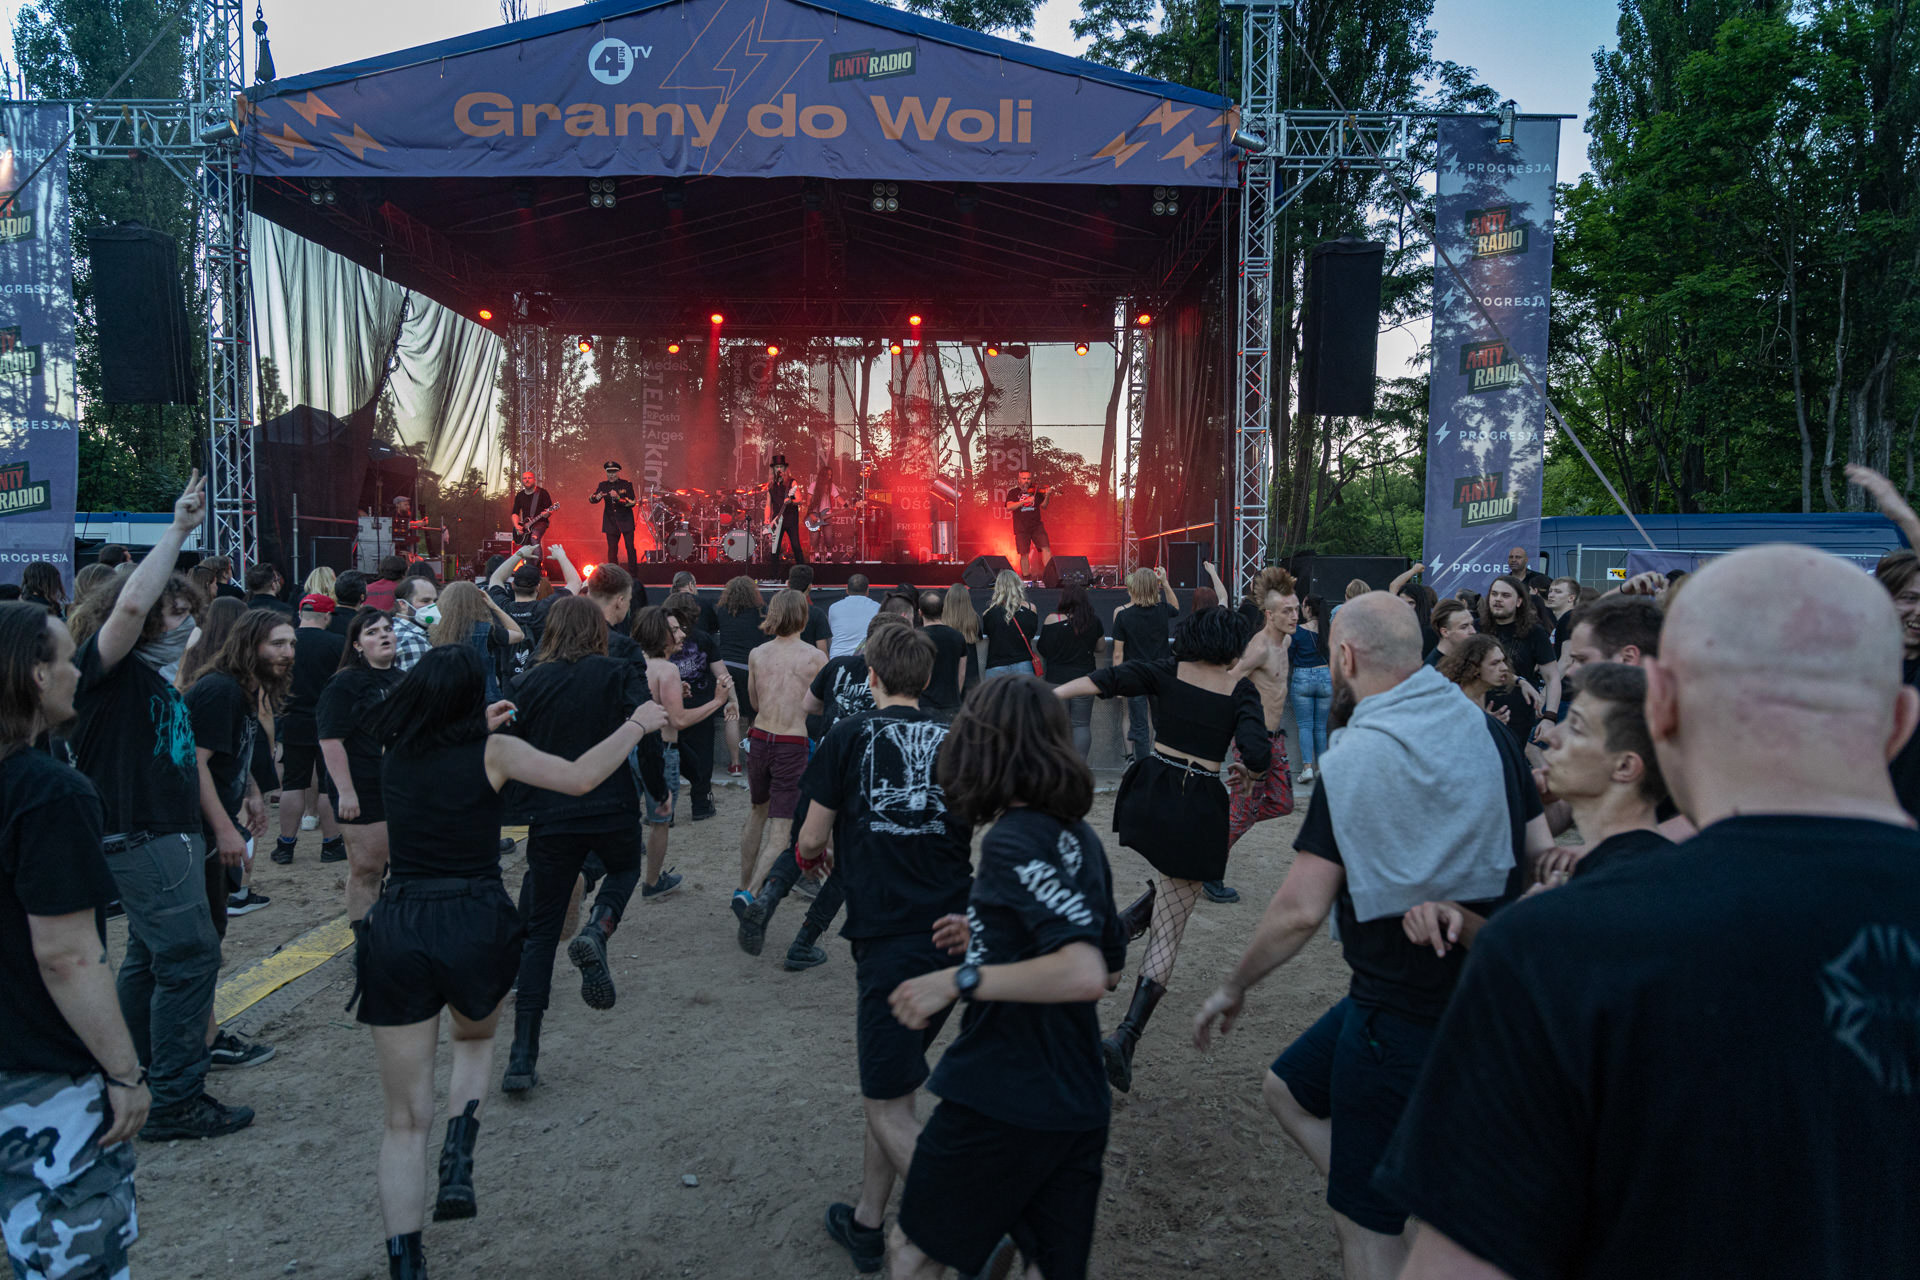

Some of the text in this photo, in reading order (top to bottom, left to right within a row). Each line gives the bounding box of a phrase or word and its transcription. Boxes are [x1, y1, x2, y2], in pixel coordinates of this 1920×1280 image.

[617, 45, 626, 63] FUN
[631, 45, 653, 58] TV
[453, 92, 1033, 147] Gramy do Woli
[1467, 162, 1553, 175] PROGRESJA
[1470, 210, 1507, 236] ANTY
[1478, 229, 1523, 254] RADIO
[1465, 346, 1504, 371] ANTY
[1474, 363, 1520, 387] RADIO
[1459, 430, 1539, 441] PROGRESJA
[1459, 479, 1498, 503] ANTY
[1468, 497, 1513, 520] RADIO
[1452, 563, 1532, 574] PROGREA
